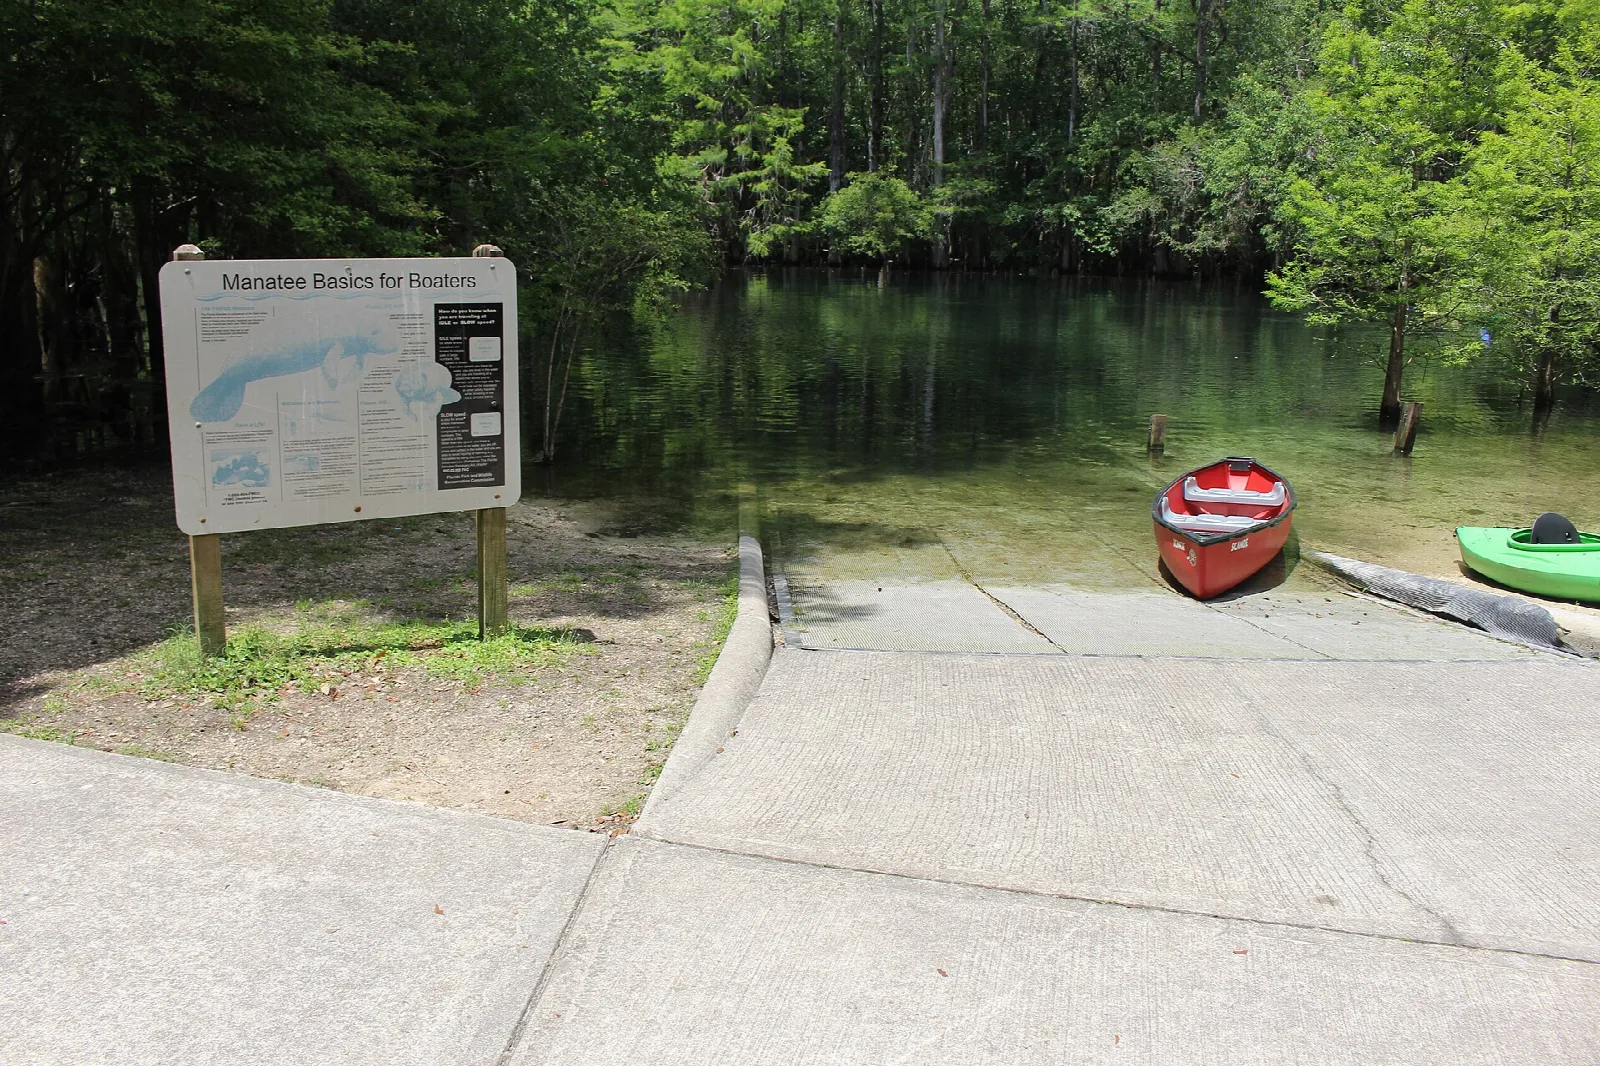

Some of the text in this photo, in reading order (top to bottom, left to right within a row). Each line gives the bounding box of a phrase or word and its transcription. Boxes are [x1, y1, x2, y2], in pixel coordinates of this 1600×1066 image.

[222, 272, 476, 290] Manatee Basics for Boaters
